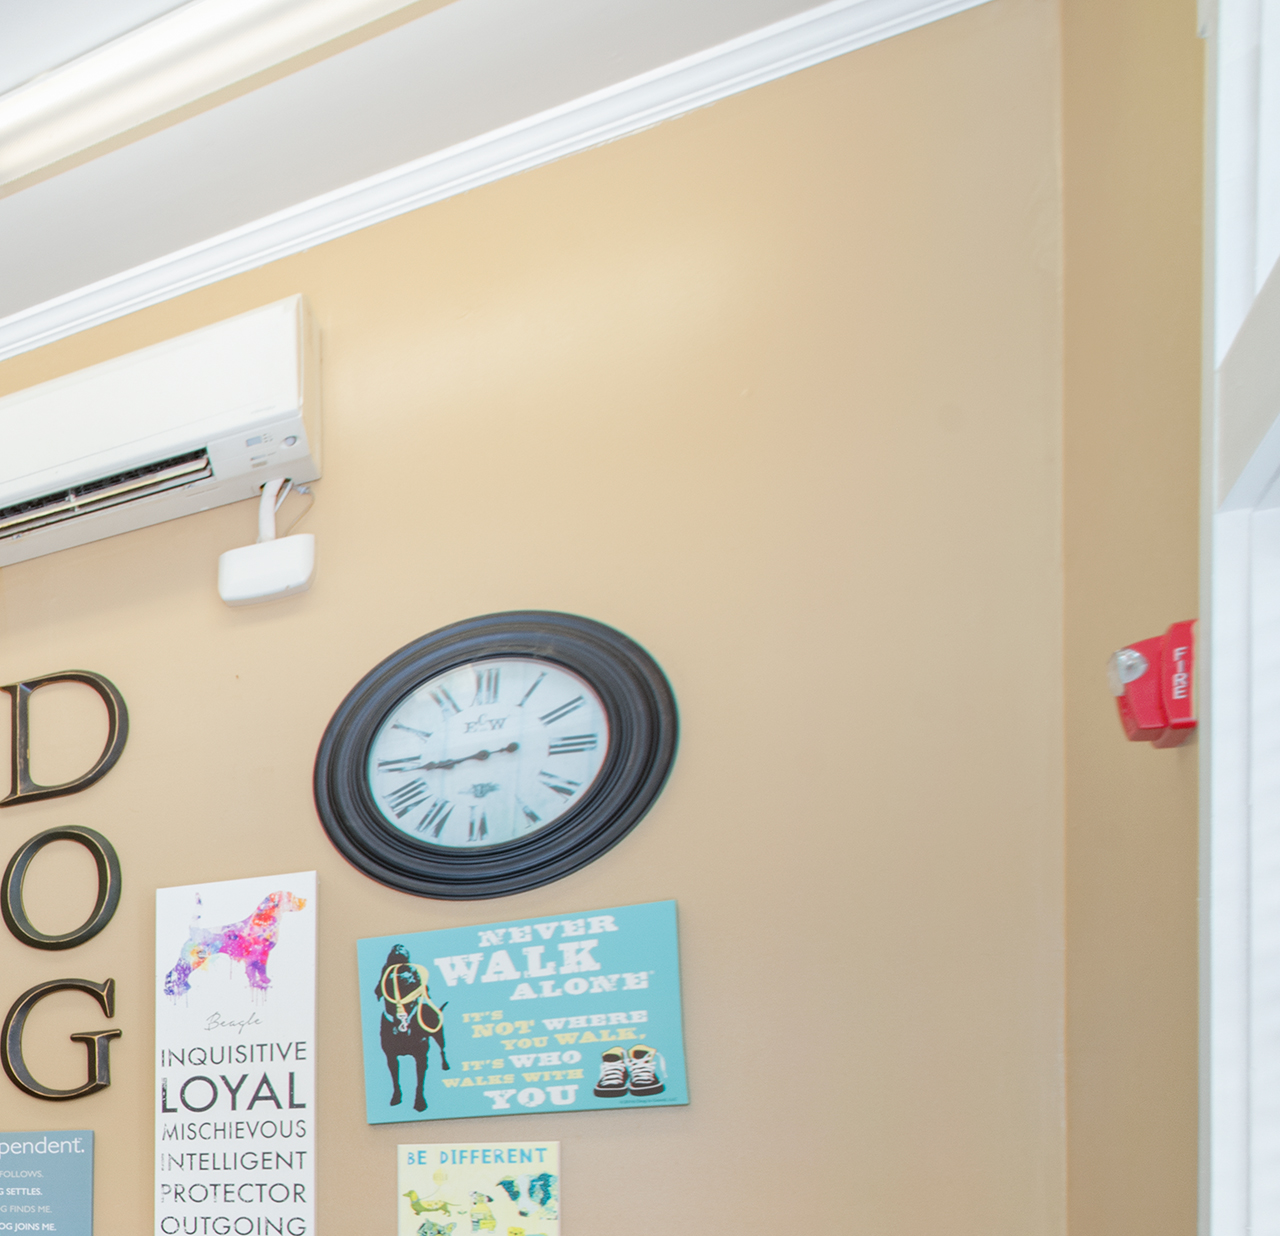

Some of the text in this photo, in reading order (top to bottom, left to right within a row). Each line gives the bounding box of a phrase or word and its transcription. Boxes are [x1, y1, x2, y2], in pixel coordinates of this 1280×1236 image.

[1172, 646, 1189, 700] FIRE
[478, 915, 619, 947] NEVER
[434, 939, 601, 986] WALK
[204, 1012, 263, 1034] Beagle
[462, 1010, 503, 1022] IT'S
[472, 1010, 648, 1038] NOT WHERE
[501, 1027, 646, 1050] YOU WALK,
[162, 1042, 306, 1067] INQUISITIVE
[462, 1050, 582, 1071] IT'S WHO
[442, 1069, 584, 1087] WALKS WITH
[162, 1072, 306, 1113] LOYAL
[484, 1084, 578, 1110] YOU
[162, 1119, 306, 1141] MISCHIEVOUS
[161, 1151, 307, 1171] INTELLIGENT
[408, 1147, 548, 1165] BE DIFFERENT
[0, 1170, 43, 1178] FOLLOWS.
[161, 1183, 306, 1203] PROTECTOR
[14, 1223, 39, 1232] JOINS
[161, 1216, 306, 1236] OUTGOING
